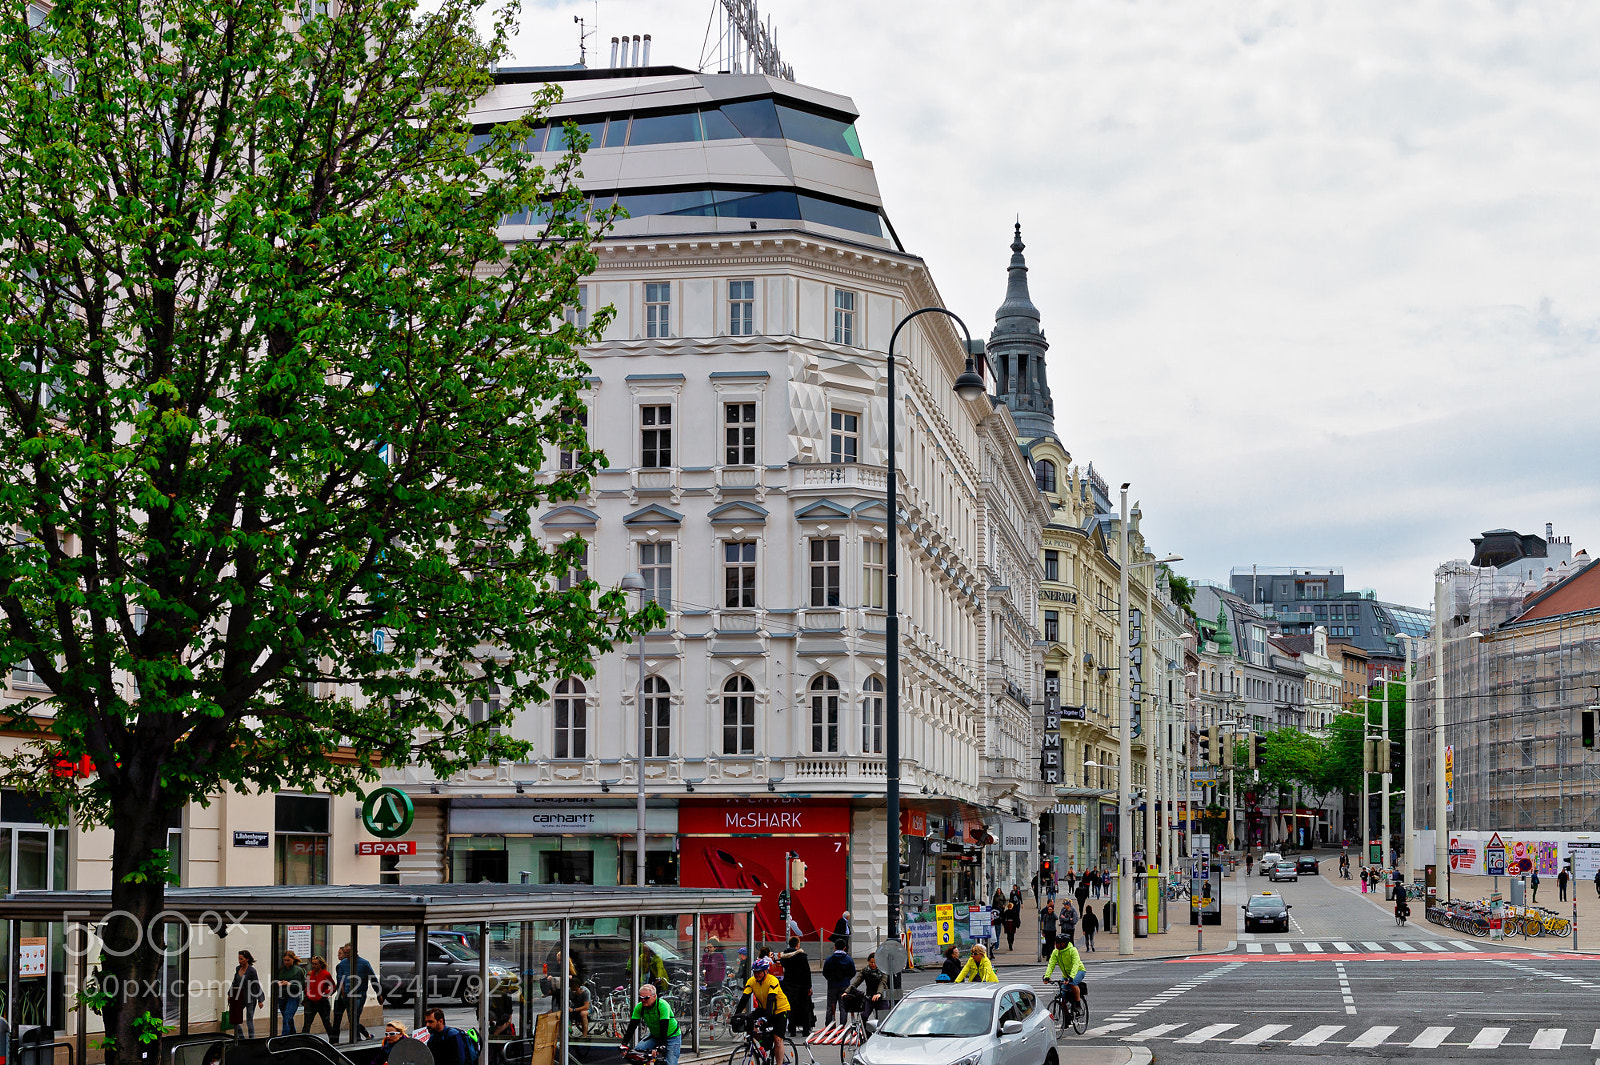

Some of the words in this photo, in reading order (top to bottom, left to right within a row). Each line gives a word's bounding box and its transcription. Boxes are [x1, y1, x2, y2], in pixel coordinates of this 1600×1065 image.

[1045, 680, 1059, 783] HIRMER
[533, 813, 595, 823] carhartt
[726, 812, 802, 828] McSHARK
[361, 843, 408, 853] SPAR
[833, 842, 842, 853] 7
